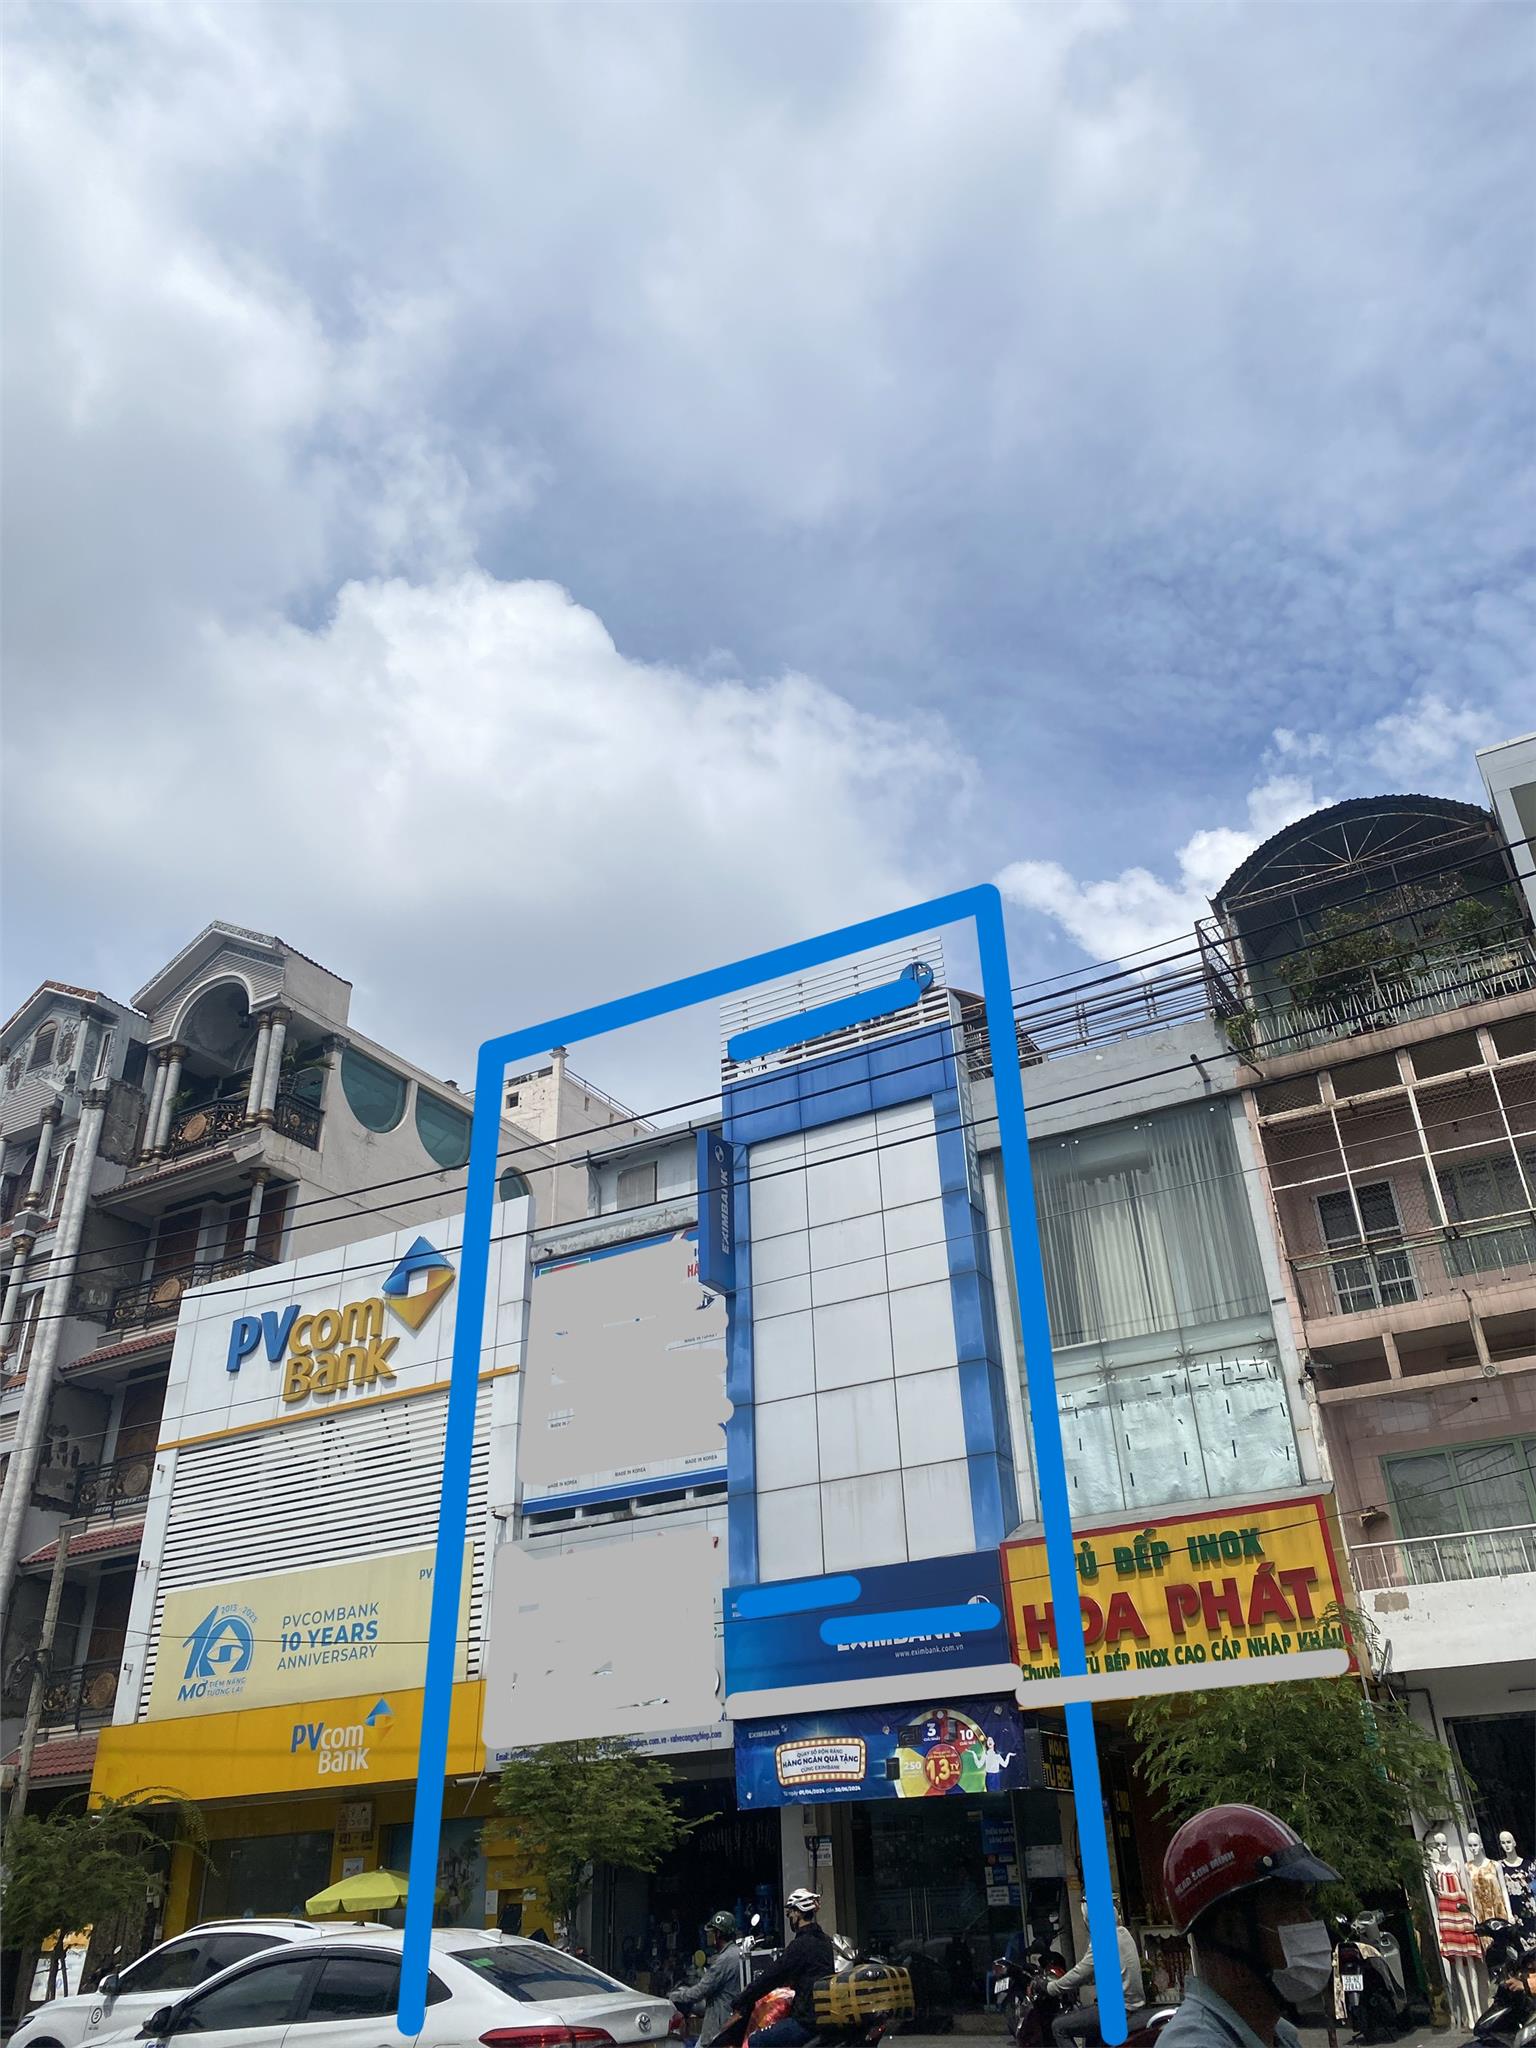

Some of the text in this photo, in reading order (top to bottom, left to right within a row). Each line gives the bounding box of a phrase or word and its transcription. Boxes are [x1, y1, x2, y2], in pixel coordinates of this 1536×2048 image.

[720, 1168, 730, 1256] EXIMBANK
[282, 1337, 400, 1403] Bank
[1073, 1528, 1265, 1579] Ủ BẾP INOX
[1164, 1562, 1318, 1634] PHÁT
[282, 1602, 379, 1629] PVCOMBANK
[280, 1620, 378, 1653] 10 YEARS
[277, 1645, 377, 1671] ANNIVERSARY
[894, 1643, 964, 1658] www.eximbank.com.vn
[1135, 1648, 1172, 1669] INOX
[1174, 1645, 1206, 1665] CAO
[748, 1729, 780, 1739] EXIMBANK
[927, 1722, 937, 1737] 3
[960, 1730, 974, 1741] 10
[318, 1747, 370, 1775] Bank
